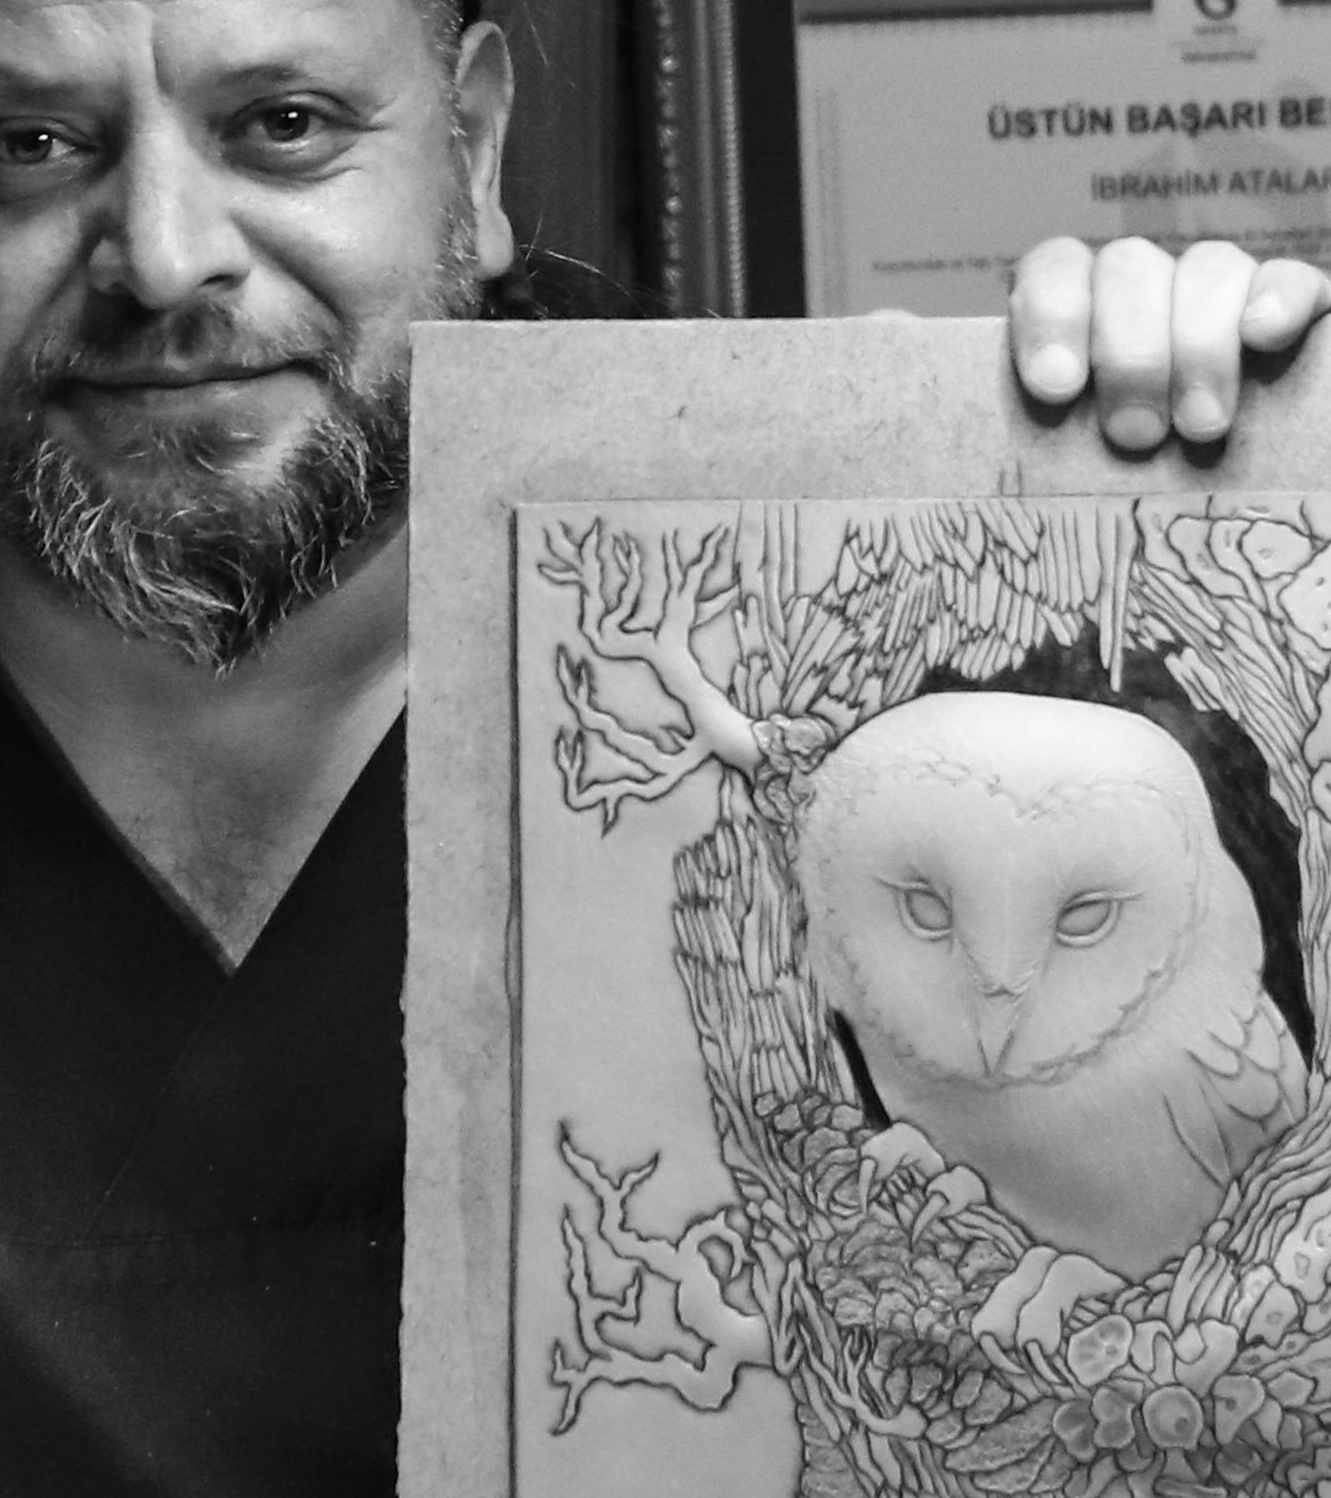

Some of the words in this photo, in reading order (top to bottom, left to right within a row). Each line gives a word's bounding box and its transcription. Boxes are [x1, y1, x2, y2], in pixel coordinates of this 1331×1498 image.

[987, 102, 1114, 140] ÜSTÜN
[1126, 99, 1267, 139] BAŞARI
[1090, 166, 1221, 202] İBRAHİM
